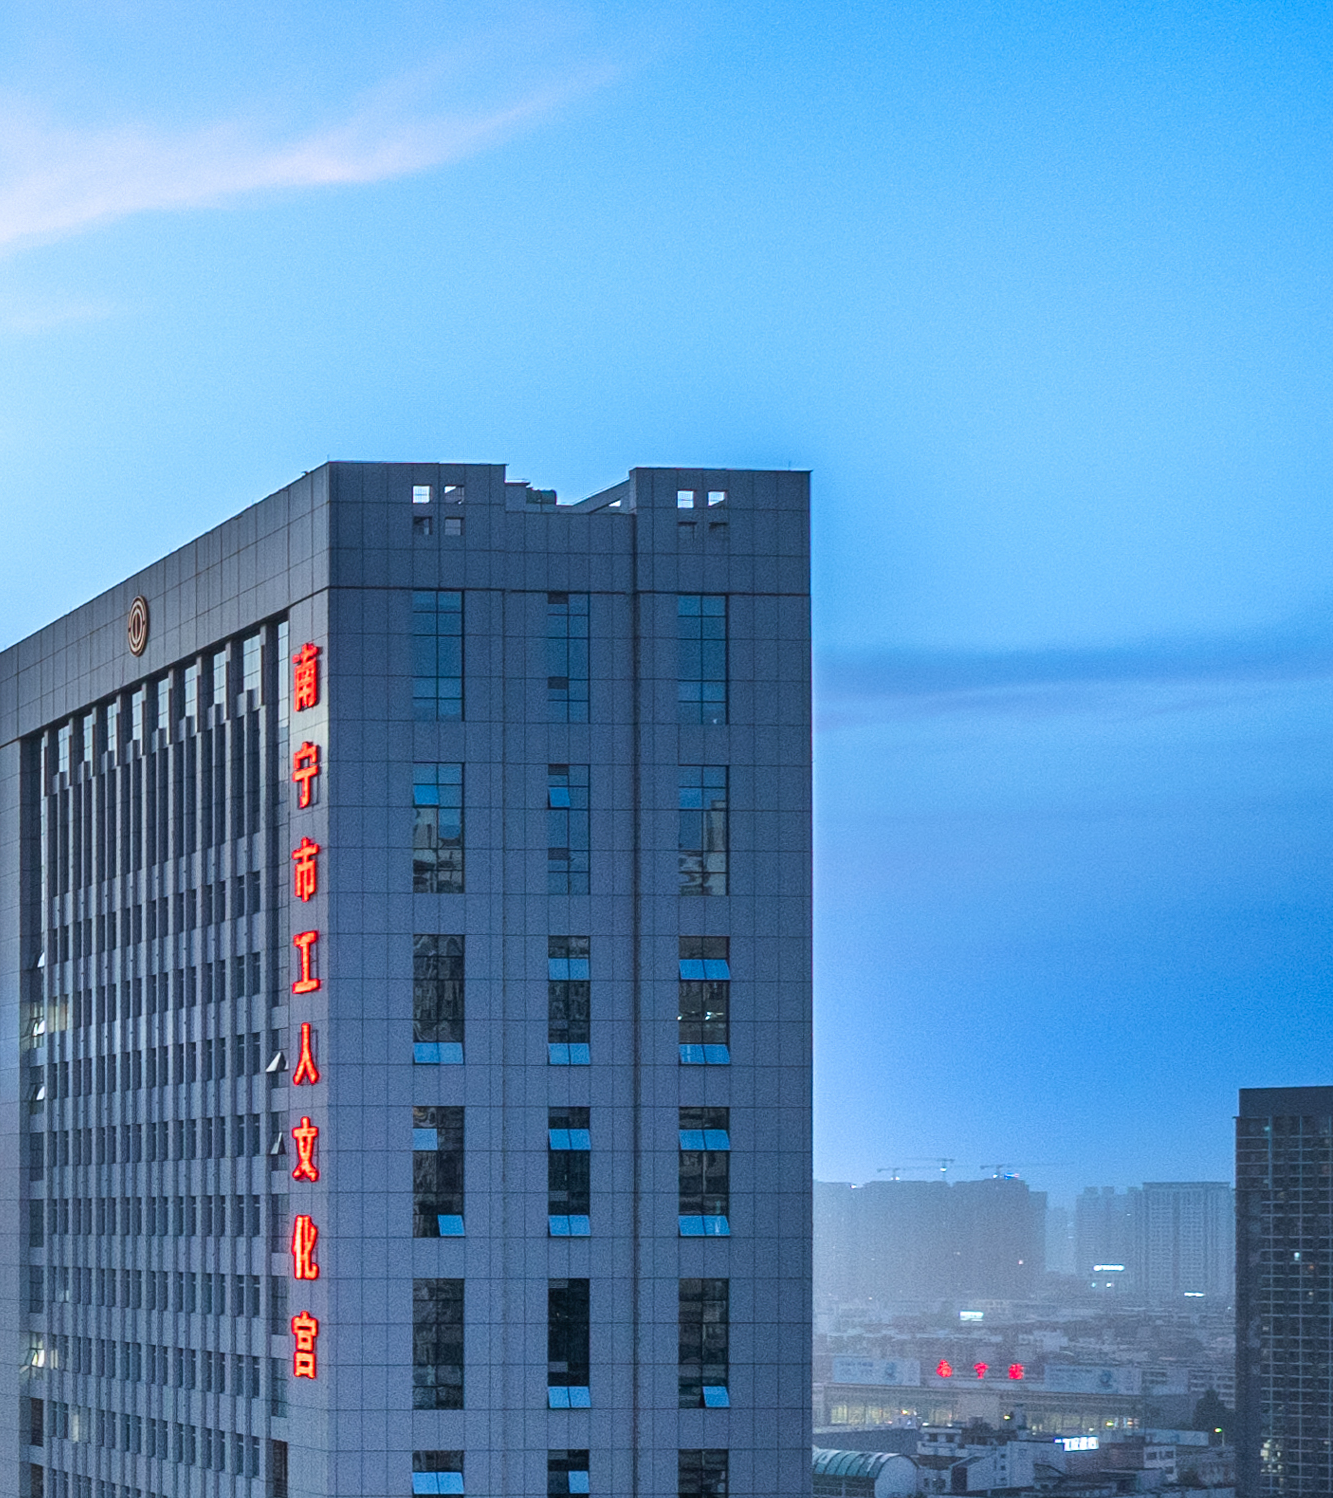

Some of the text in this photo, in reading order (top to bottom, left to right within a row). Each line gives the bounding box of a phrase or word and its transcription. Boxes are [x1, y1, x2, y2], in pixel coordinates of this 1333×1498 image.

[291, 642, 321, 1379] 南宁市工人文化宫
